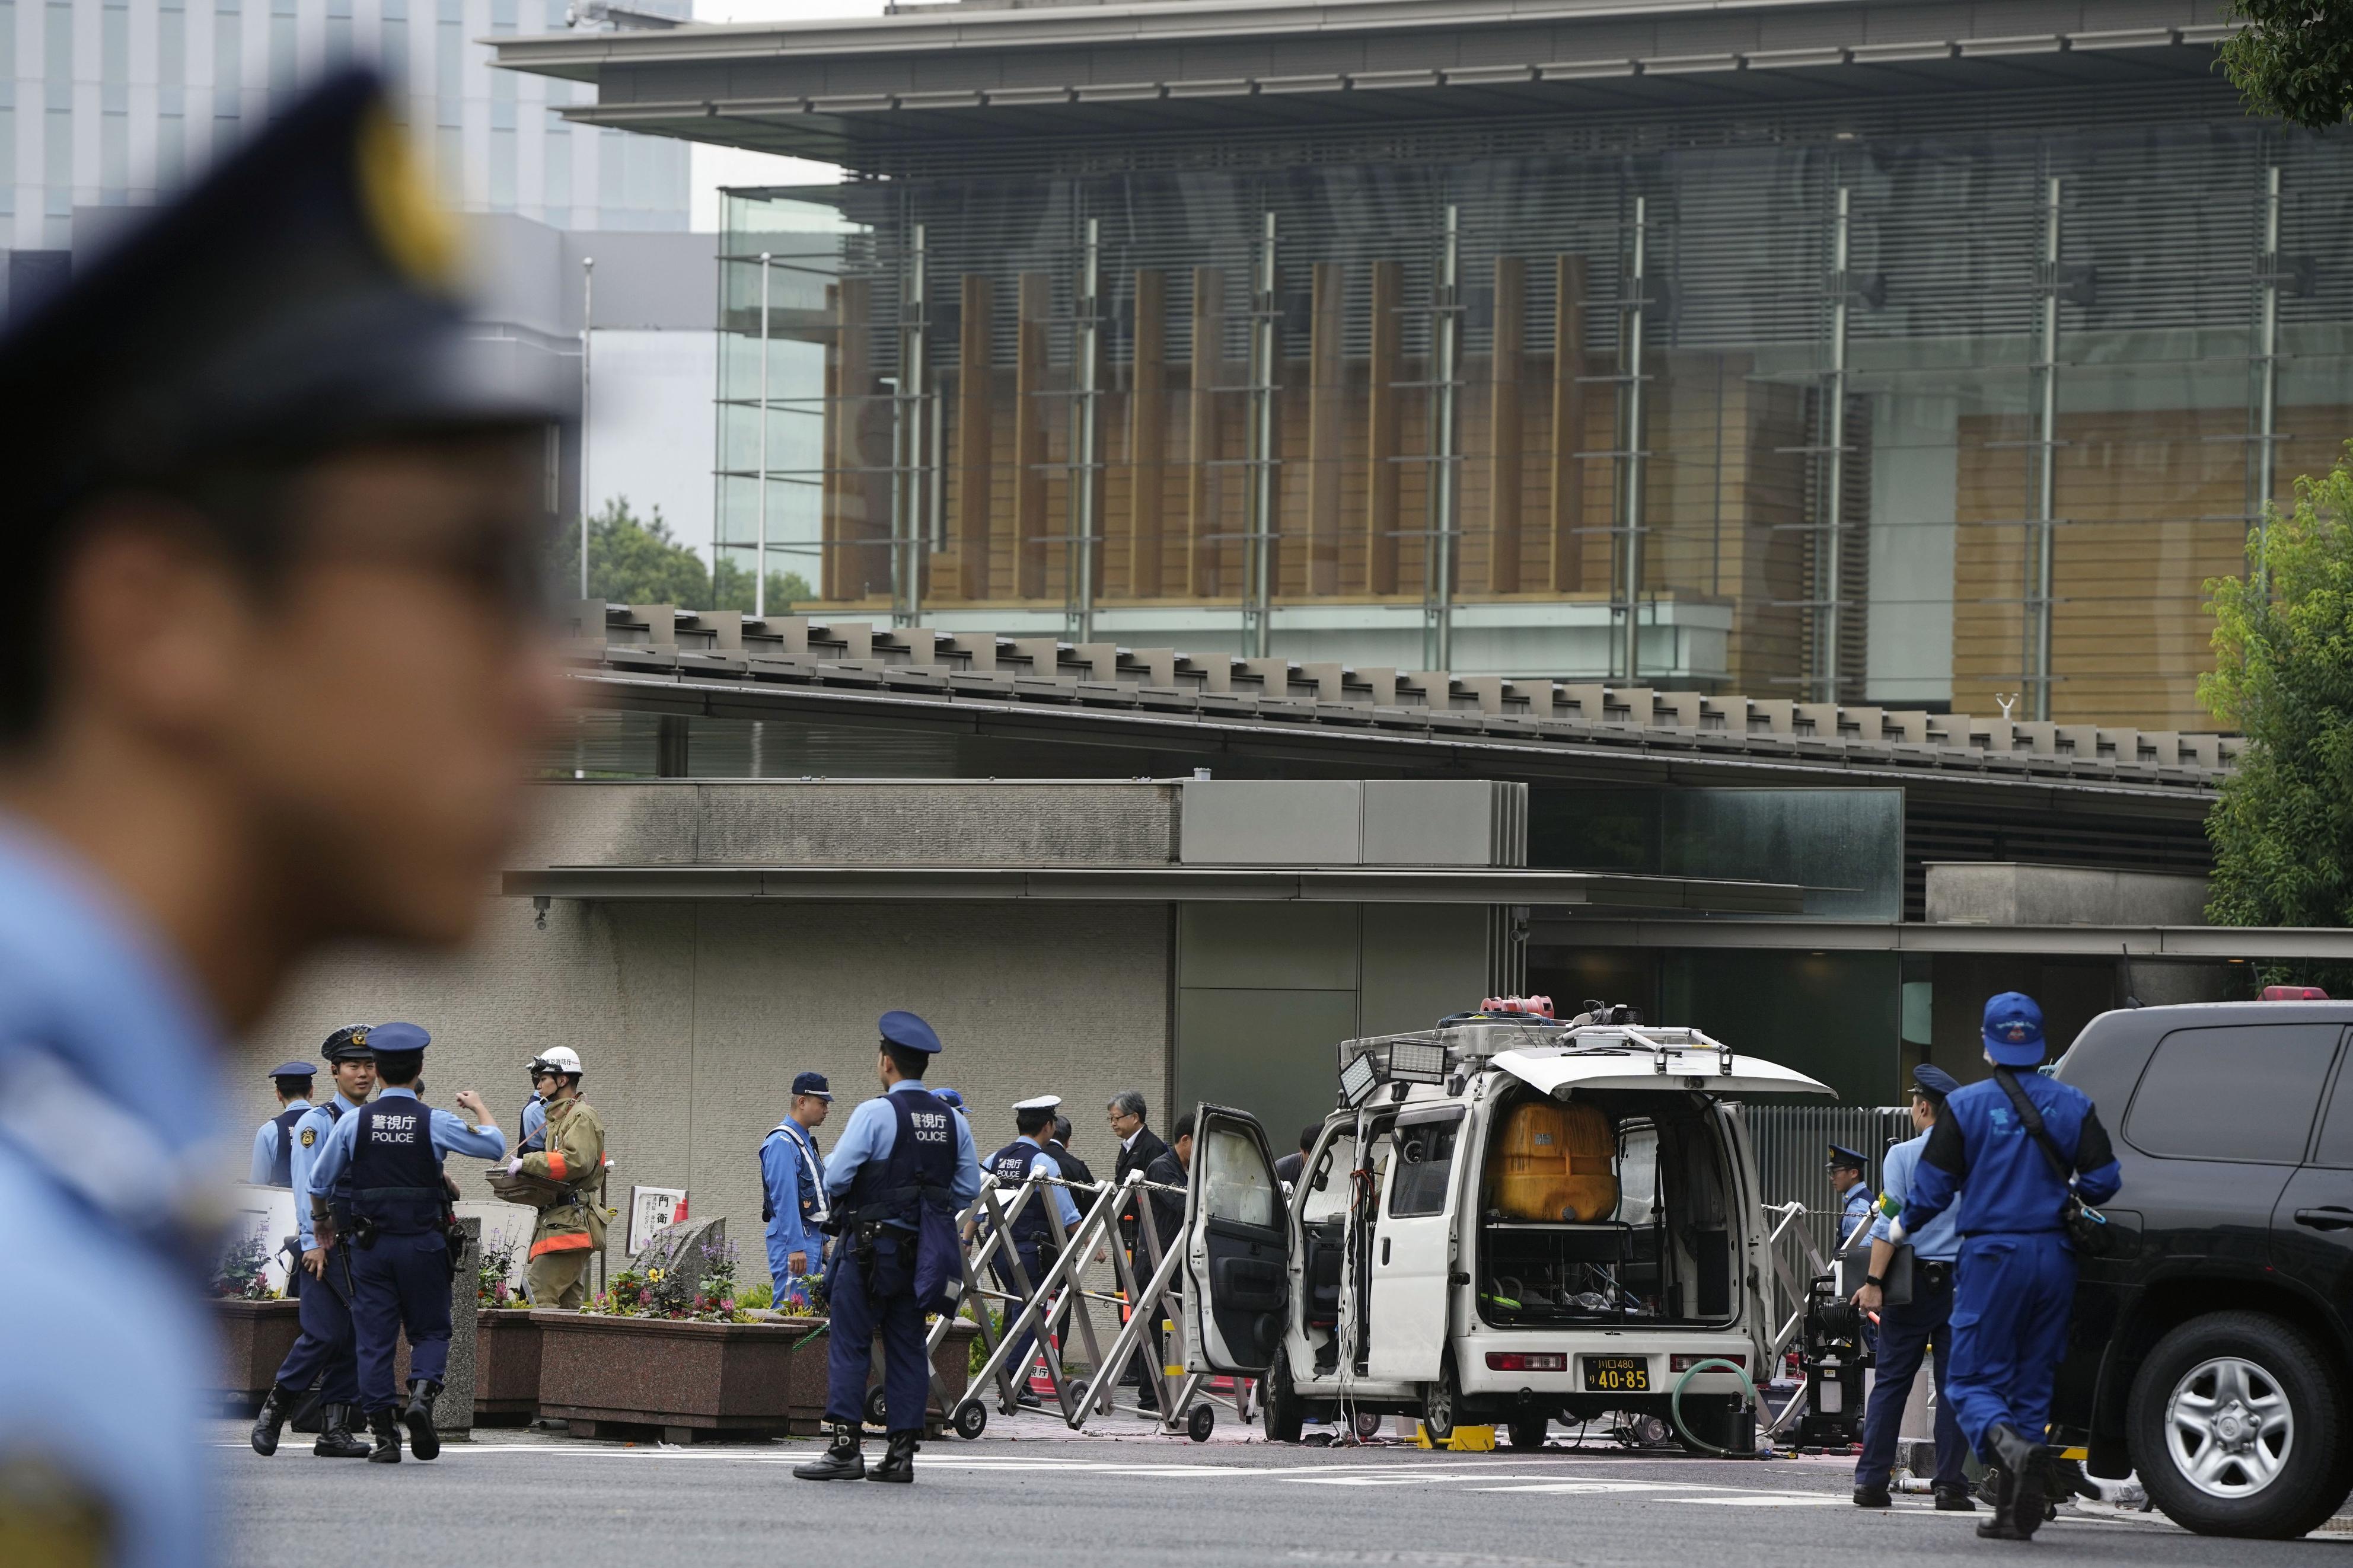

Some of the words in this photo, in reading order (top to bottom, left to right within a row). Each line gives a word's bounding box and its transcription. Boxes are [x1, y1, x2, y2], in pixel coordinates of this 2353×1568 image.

[371, 1114, 417, 1130] 警視庁
[911, 1112, 947, 1129] 警視庁
[372, 1132, 415, 1143] POLICE
[915, 1130, 948, 1142] OLICE
[998, 1158, 1023, 1169] 警視庁
[656, 1196, 669, 1224] 門衛
[1599, 1359, 1617, 1369] 川口
[1618, 1359, 1634, 1369] 480
[1589, 1375, 1595, 1384] り
[1599, 1371, 1646, 1388] 40-85
